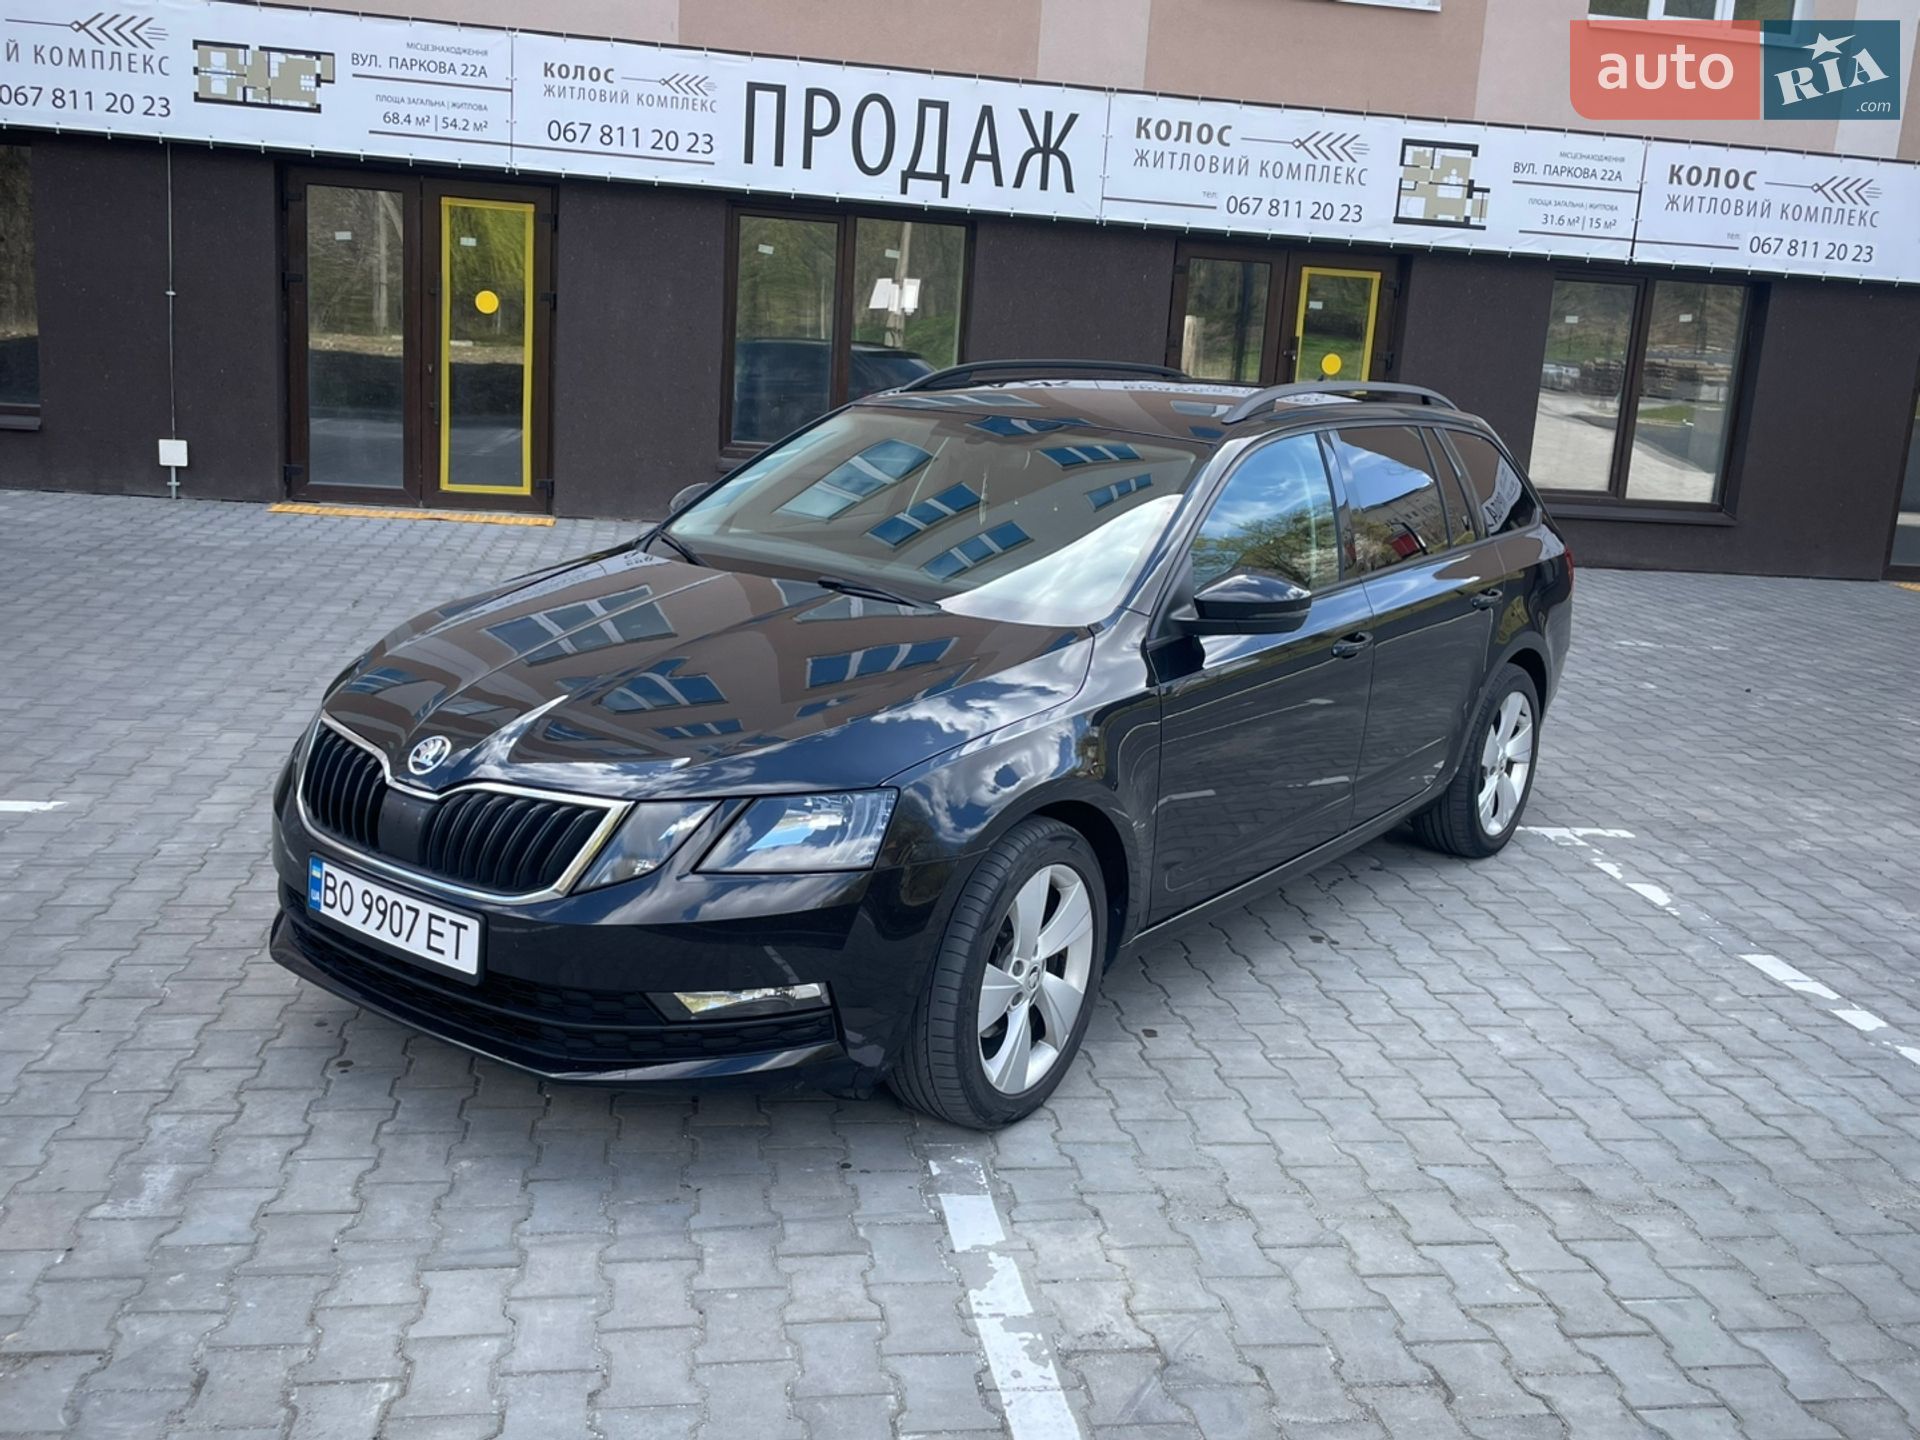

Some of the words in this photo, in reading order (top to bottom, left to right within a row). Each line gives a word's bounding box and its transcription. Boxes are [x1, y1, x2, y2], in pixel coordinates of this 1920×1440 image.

[34, 44, 170, 76] КОМПЛЕКС
[351, 52, 382, 68] ВУЛ.
[388, 56, 457, 75] ПАРКОВА
[460, 63, 488, 78] 22А
[543, 62, 615, 84] КОЛОС
[0, 84, 43, 106] 067
[52, 88, 93, 111] 811
[105, 92, 134, 114] 20
[142, 95, 171, 117] 23
[376, 94, 405, 104] ПЛОЩА
[407, 95, 446, 108] ЗАГАЛЬНА
[451, 102, 488, 112] ЖИТЛОВА
[543, 83, 630, 105] ЖИТЛОВИЙ
[636, 92, 717, 113] КОМПЛЕКС
[382, 111, 412, 125] 68.4
[441, 116, 470, 131] 54.2
[1135, 117, 1233, 147] КОЛОС
[547, 119, 591, 143] 067
[599, 124, 640, 148] 811
[650, 129, 679, 152] 20
[686, 132, 714, 155] 23
[744, 81, 1080, 199] ПРОДАЖ
[1133, 148, 1250, 177] ЖИТЛОВИЙ
[1258, 159, 1369, 187] КОМПЛЕКС
[1513, 162, 1538, 175] ВУЛ.
[1543, 164, 1598, 180] ПАРКОВА
[1600, 169, 1623, 182] 22А
[1668, 163, 1758, 191] КОЛОС
[1226, 195, 1263, 215] 067
[1267, 199, 1301, 219] 811
[1310, 201, 1334, 221] 20
[1339, 203, 1363, 223] 23
[1541, 213, 1565, 226] 31.6
[1589, 217, 1601, 229] 15
[1664, 193, 1772, 219] ЖИТЛОВИЙ
[1780, 203, 1880, 228] КОМПЛЕКС
[1749, 236, 1784, 256] 067
[1787, 239, 1819, 259] 811
[1825, 242, 1848, 261] 20
[1851, 244, 1874, 263] 23
[323, 870, 354, 917] BO
[361, 889, 420, 943] 9907
[426, 912, 468, 960] ET
